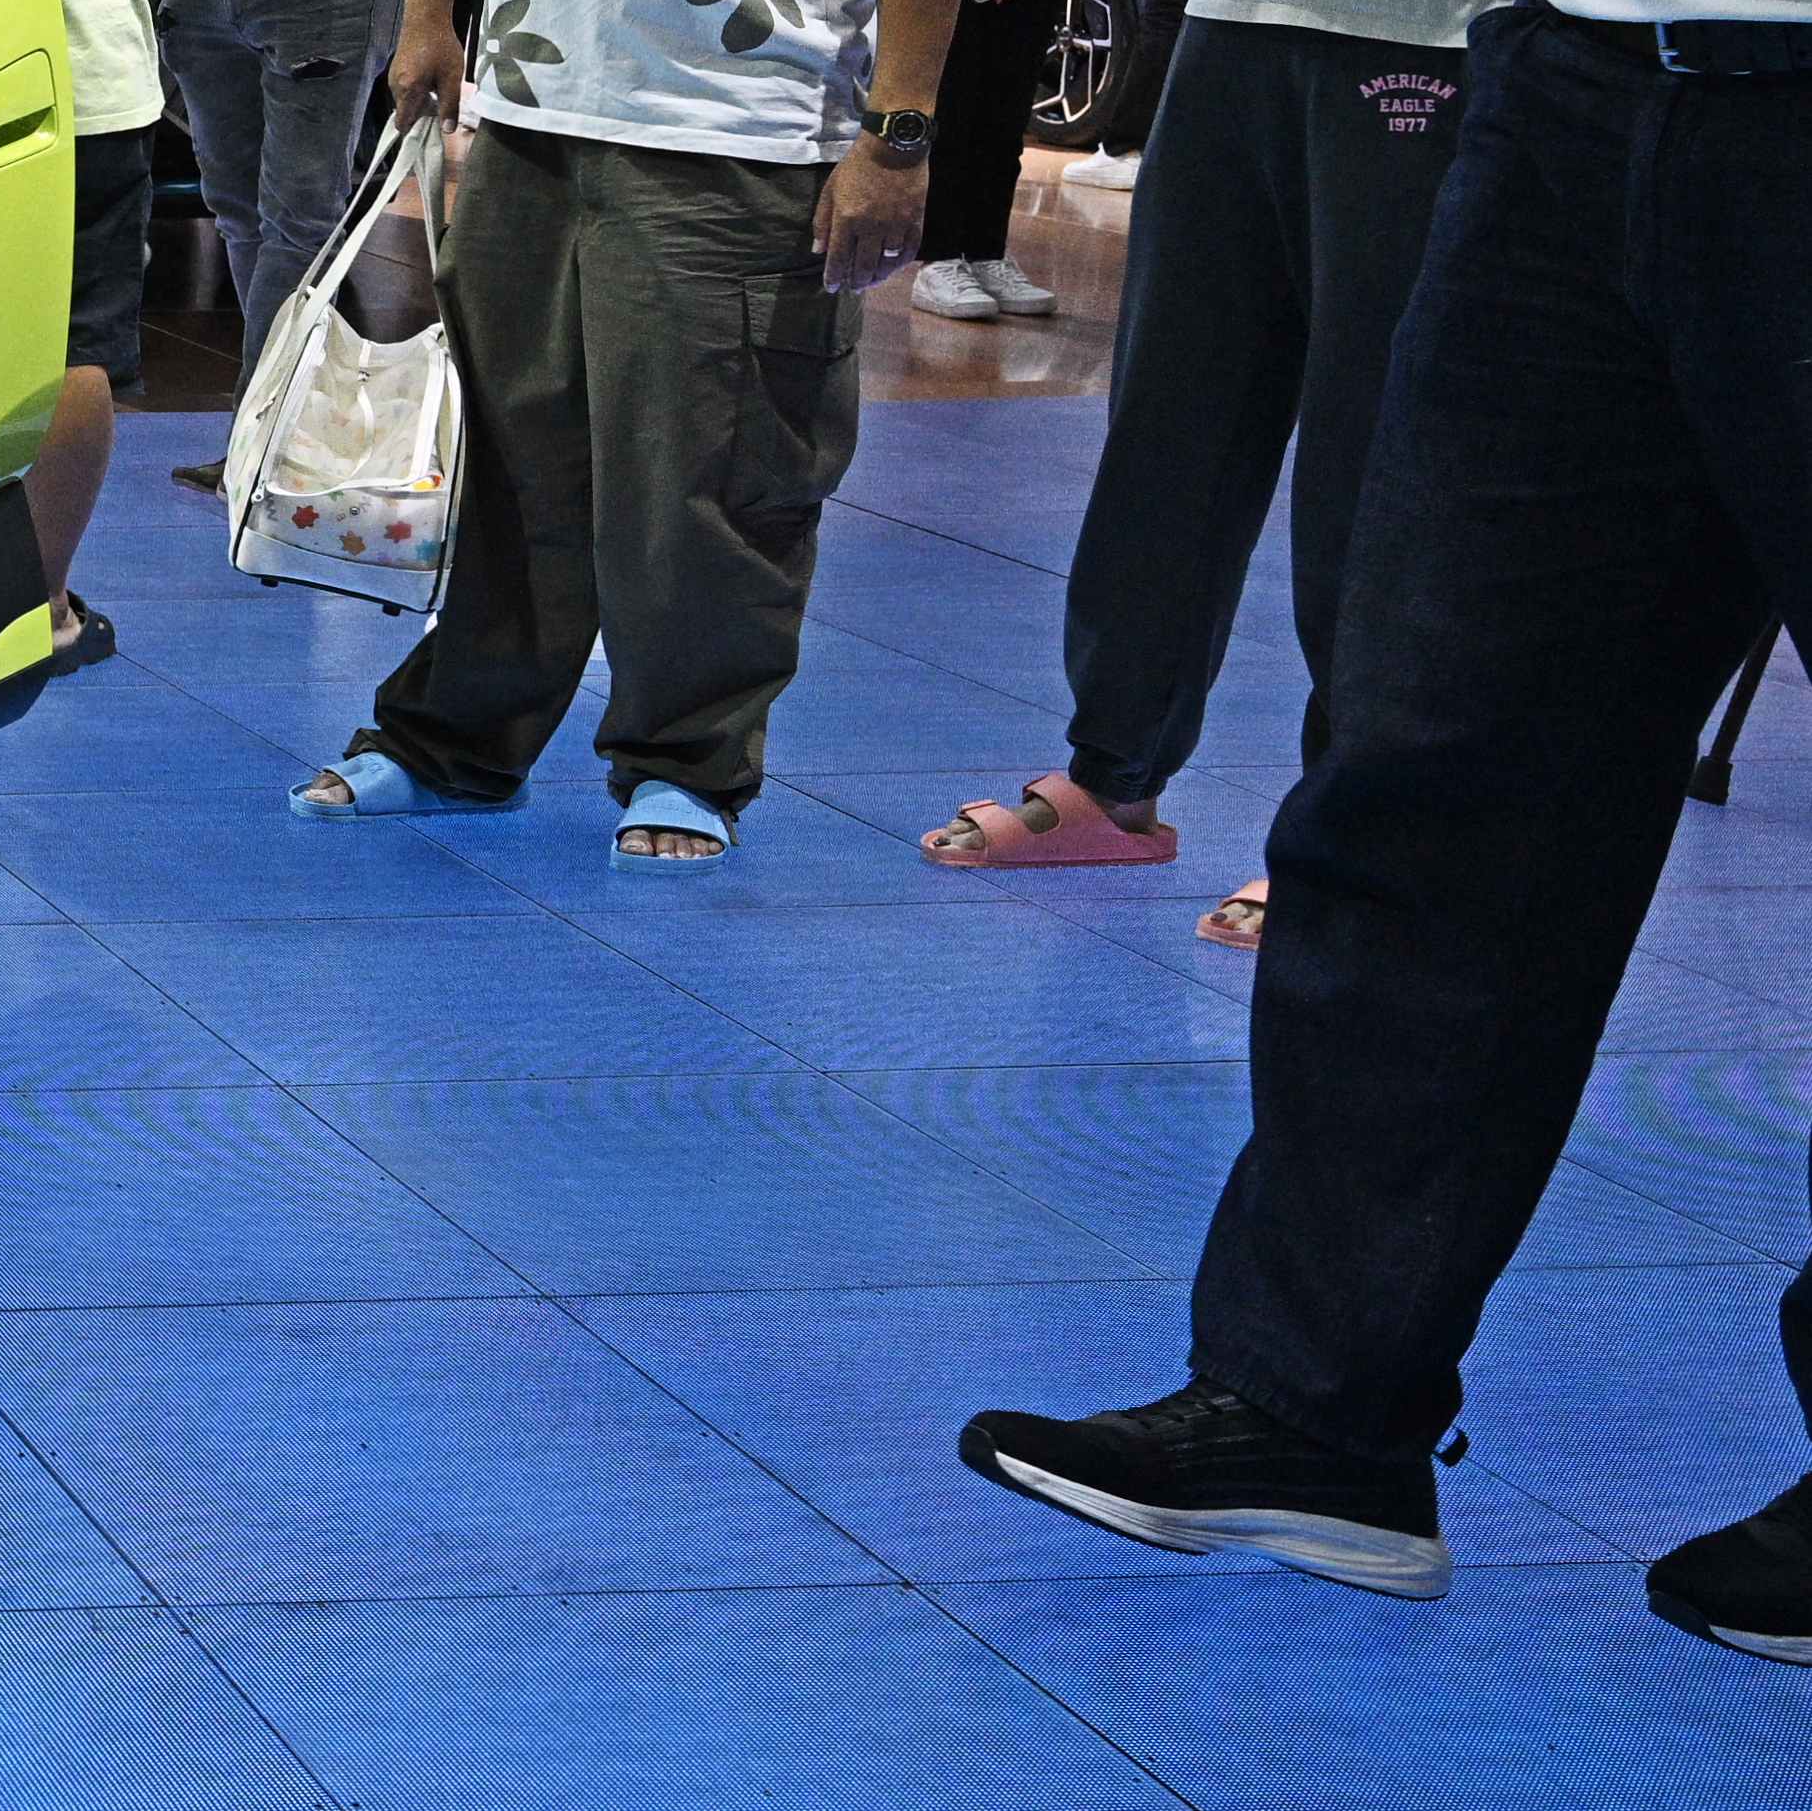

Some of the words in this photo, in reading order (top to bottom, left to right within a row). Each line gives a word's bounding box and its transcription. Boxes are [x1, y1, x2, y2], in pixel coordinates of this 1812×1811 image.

[1359, 74, 1457, 99] AMERICAN
[1379, 99, 1436, 113] EAGLE
[1389, 118, 1427, 132] 1977
